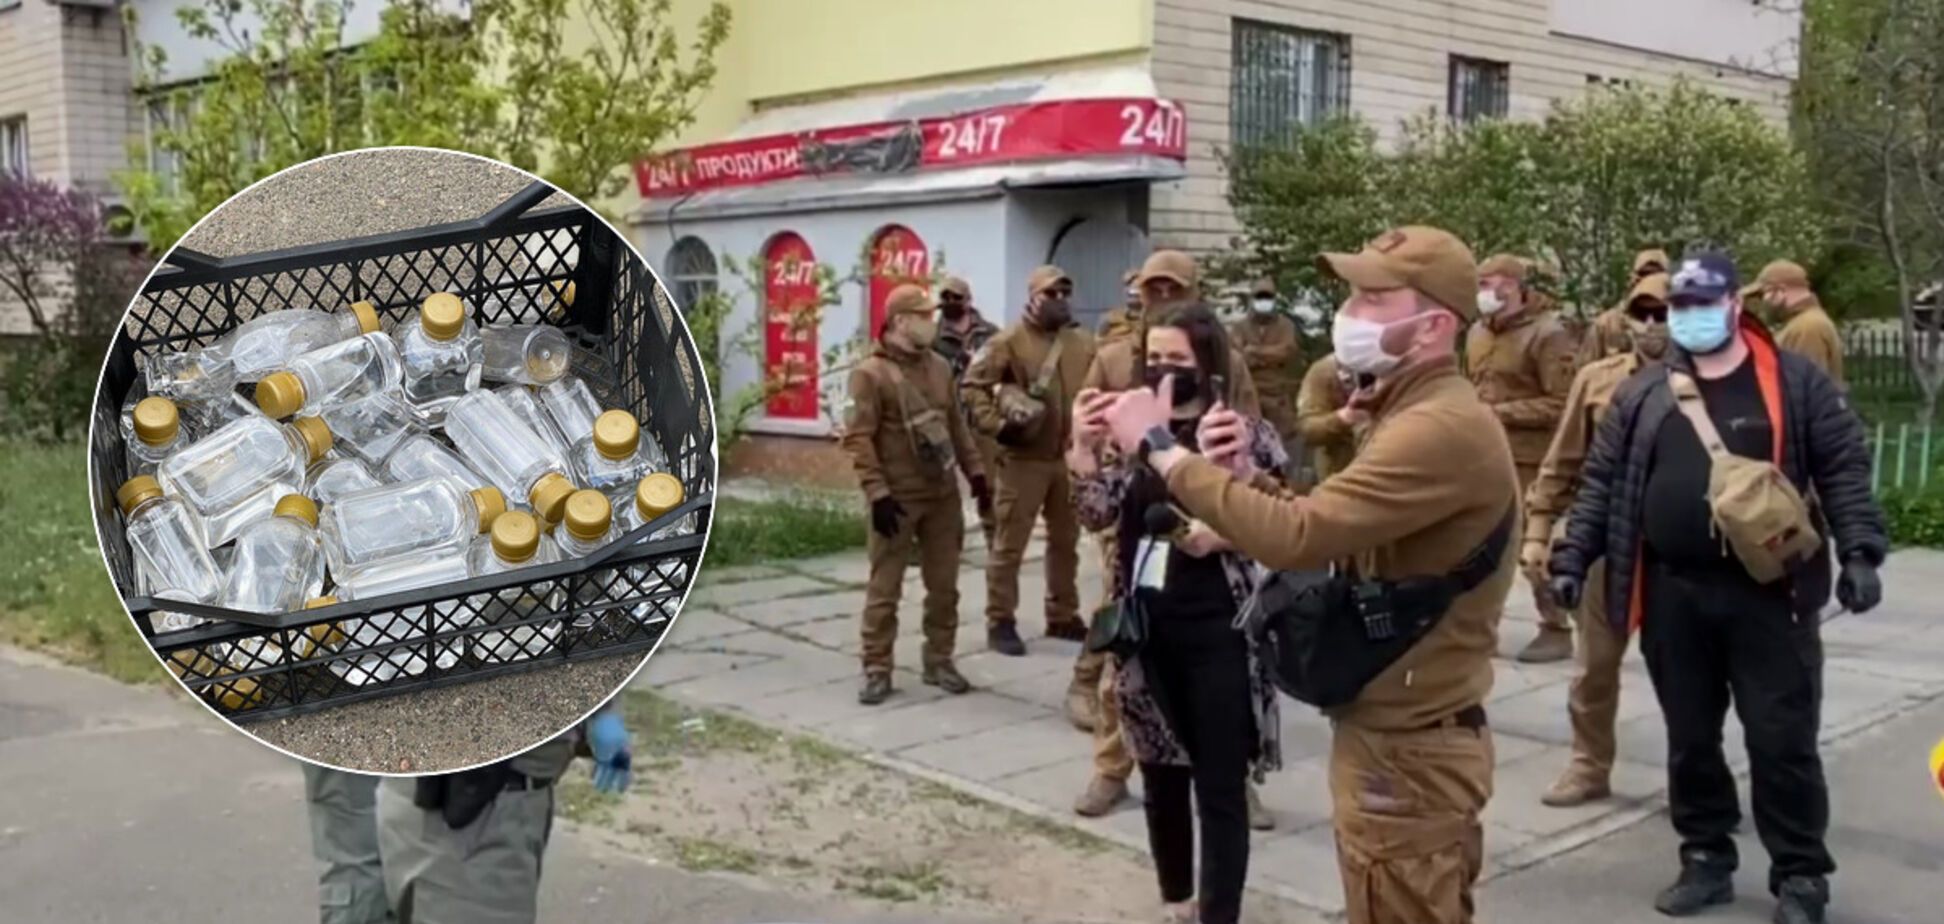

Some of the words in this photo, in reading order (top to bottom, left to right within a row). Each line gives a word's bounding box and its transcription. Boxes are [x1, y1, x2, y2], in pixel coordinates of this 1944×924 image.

[695, 148, 801, 181] ПРОДУКТИ
[938, 115, 1006, 158] 24/7
[1119, 105, 1183, 148] 24/7
[773, 261, 814, 286] 24/7
[882, 250, 924, 276] 24/7
